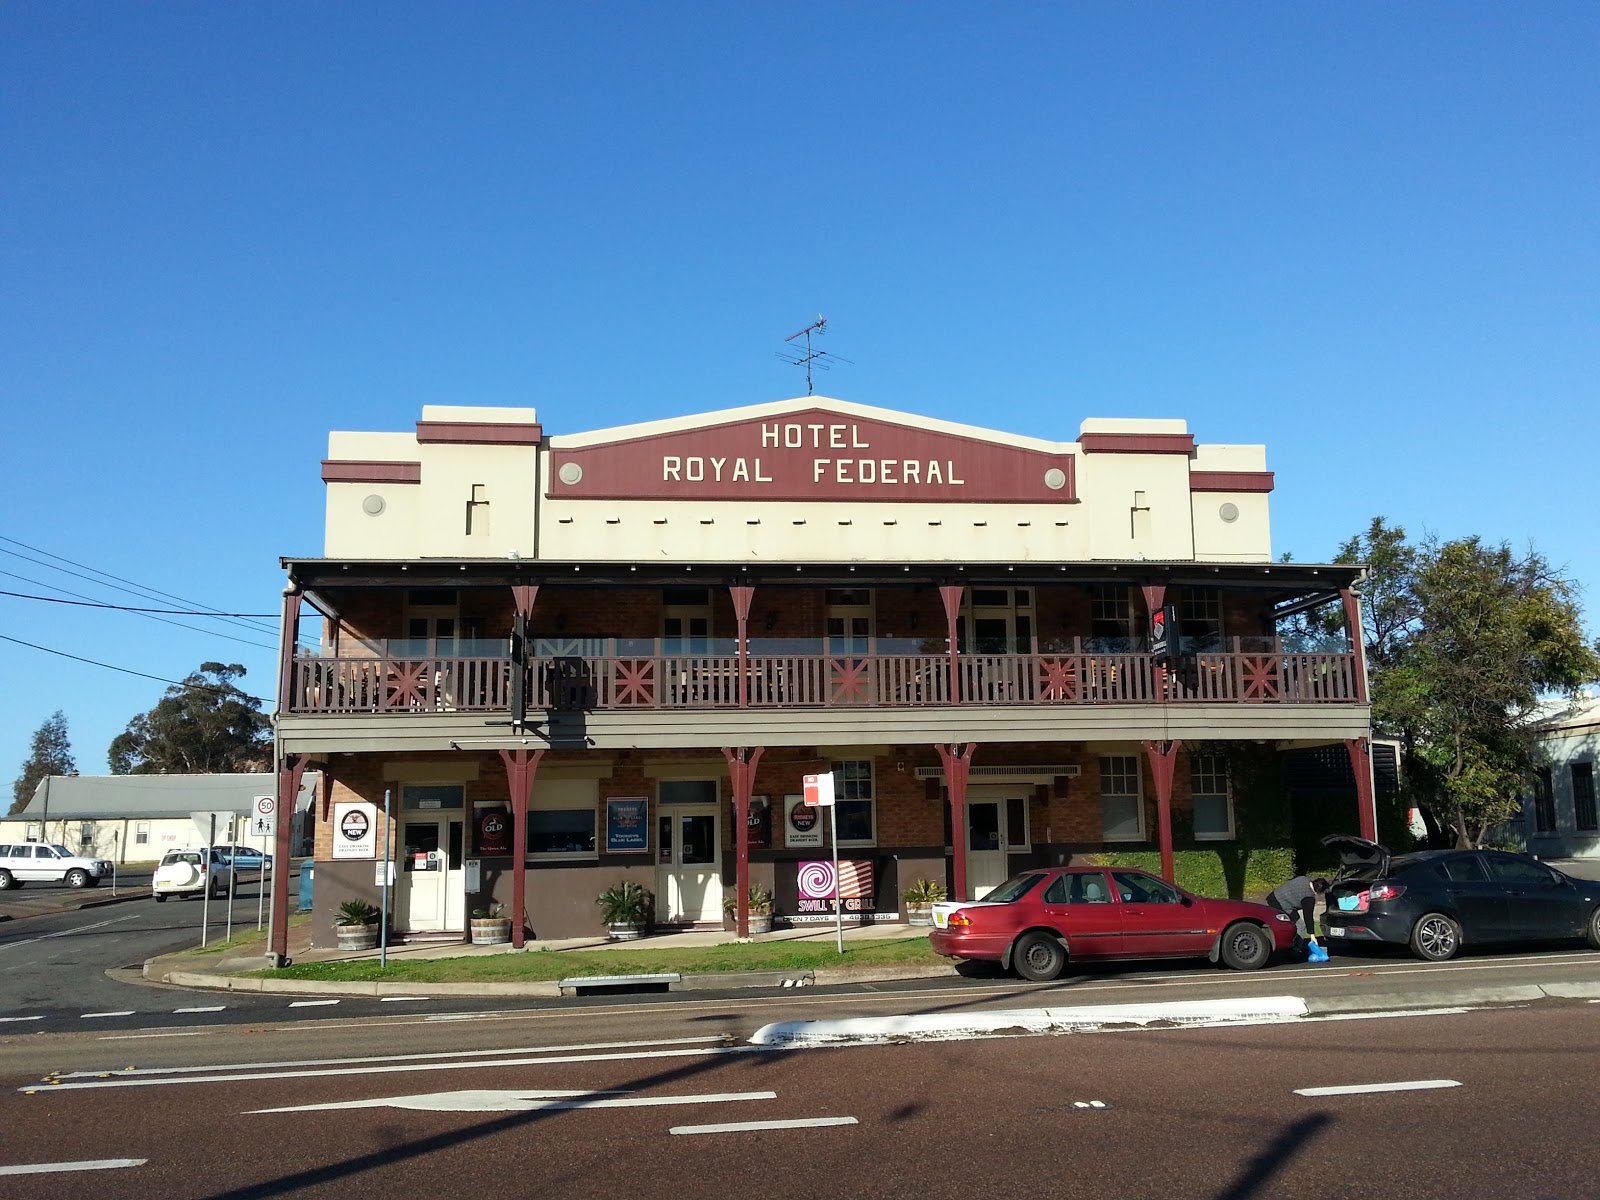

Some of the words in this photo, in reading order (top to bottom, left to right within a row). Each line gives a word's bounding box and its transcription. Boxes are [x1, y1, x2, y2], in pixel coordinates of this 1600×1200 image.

[762, 423, 870, 449] HOTEL
[663, 456, 774, 482] ROYAL
[813, 458, 965, 485] FEDERAL
[261, 802, 271, 810] 50
[485, 824, 503, 832] OLD
[798, 899, 828, 912] SWILL
[845, 898, 876, 911] GRILL
